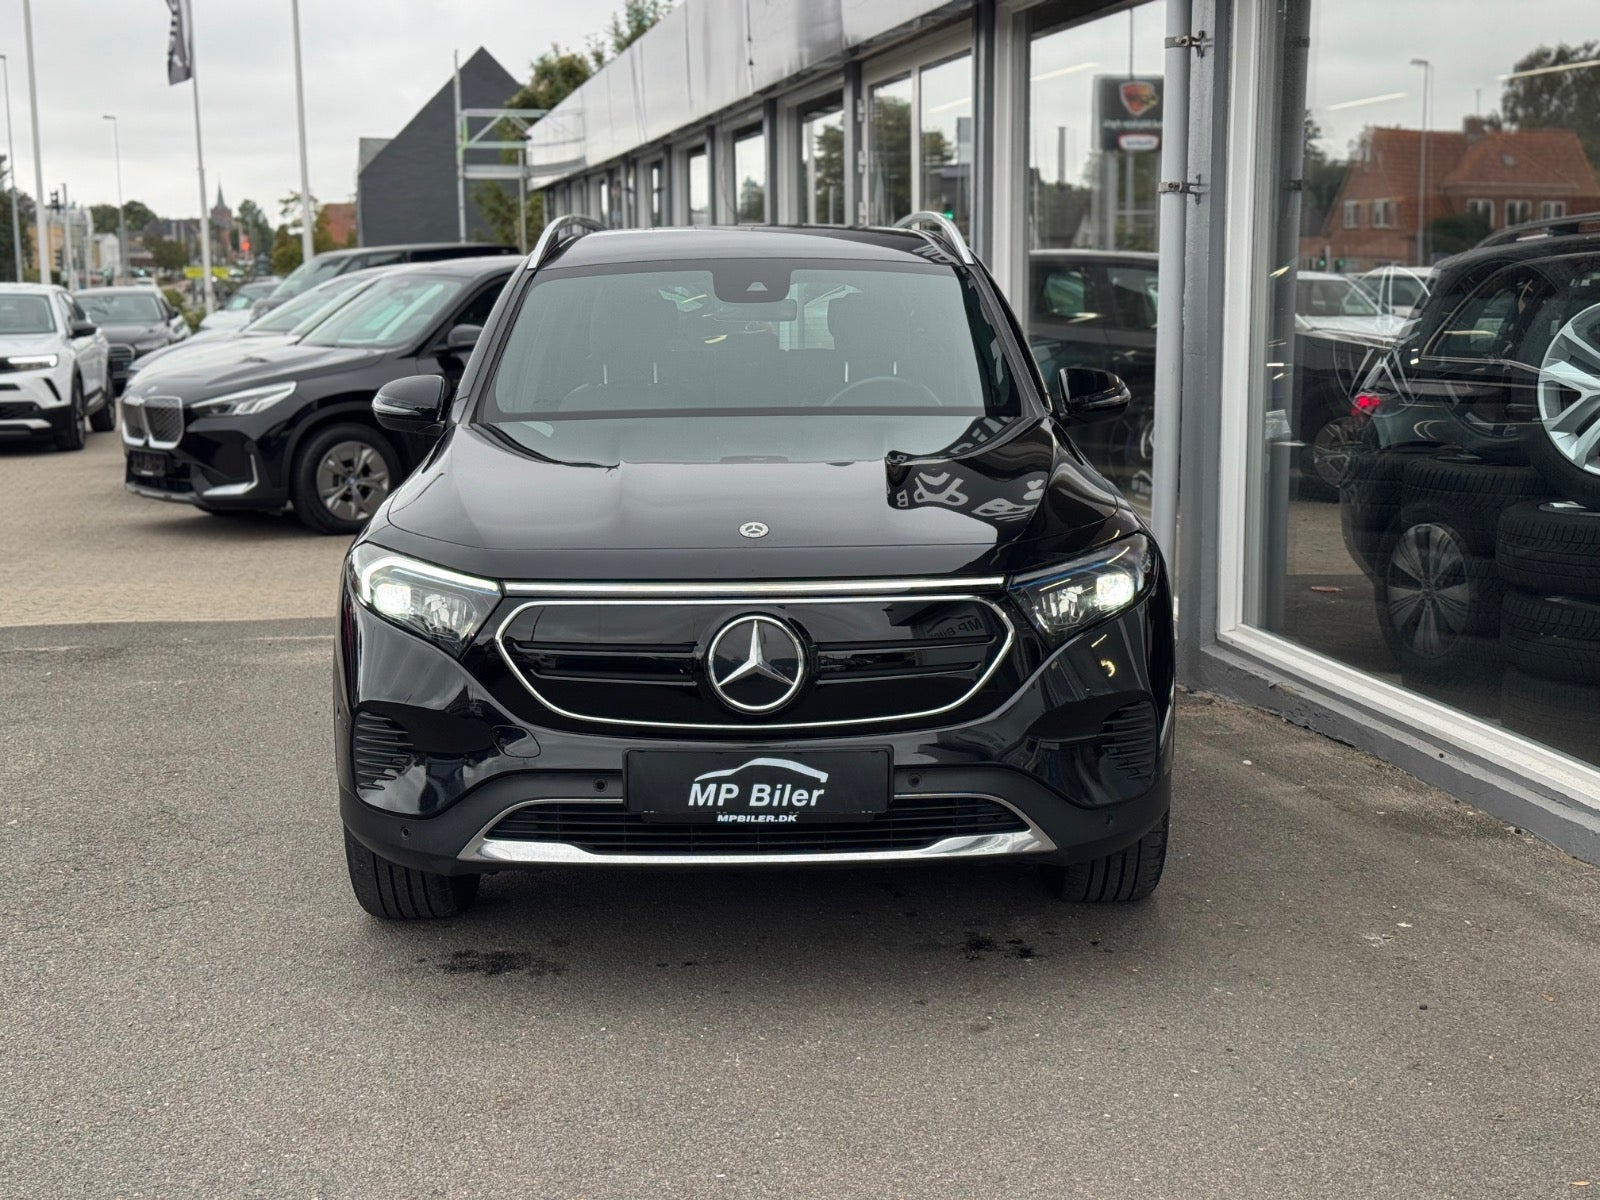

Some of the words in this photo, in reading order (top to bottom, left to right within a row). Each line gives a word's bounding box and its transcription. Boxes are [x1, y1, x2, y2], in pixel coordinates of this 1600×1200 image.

[688, 783, 739, 806] MP
[749, 784, 824, 807] Biler
[717, 814, 798, 823] MPBILER.DK
